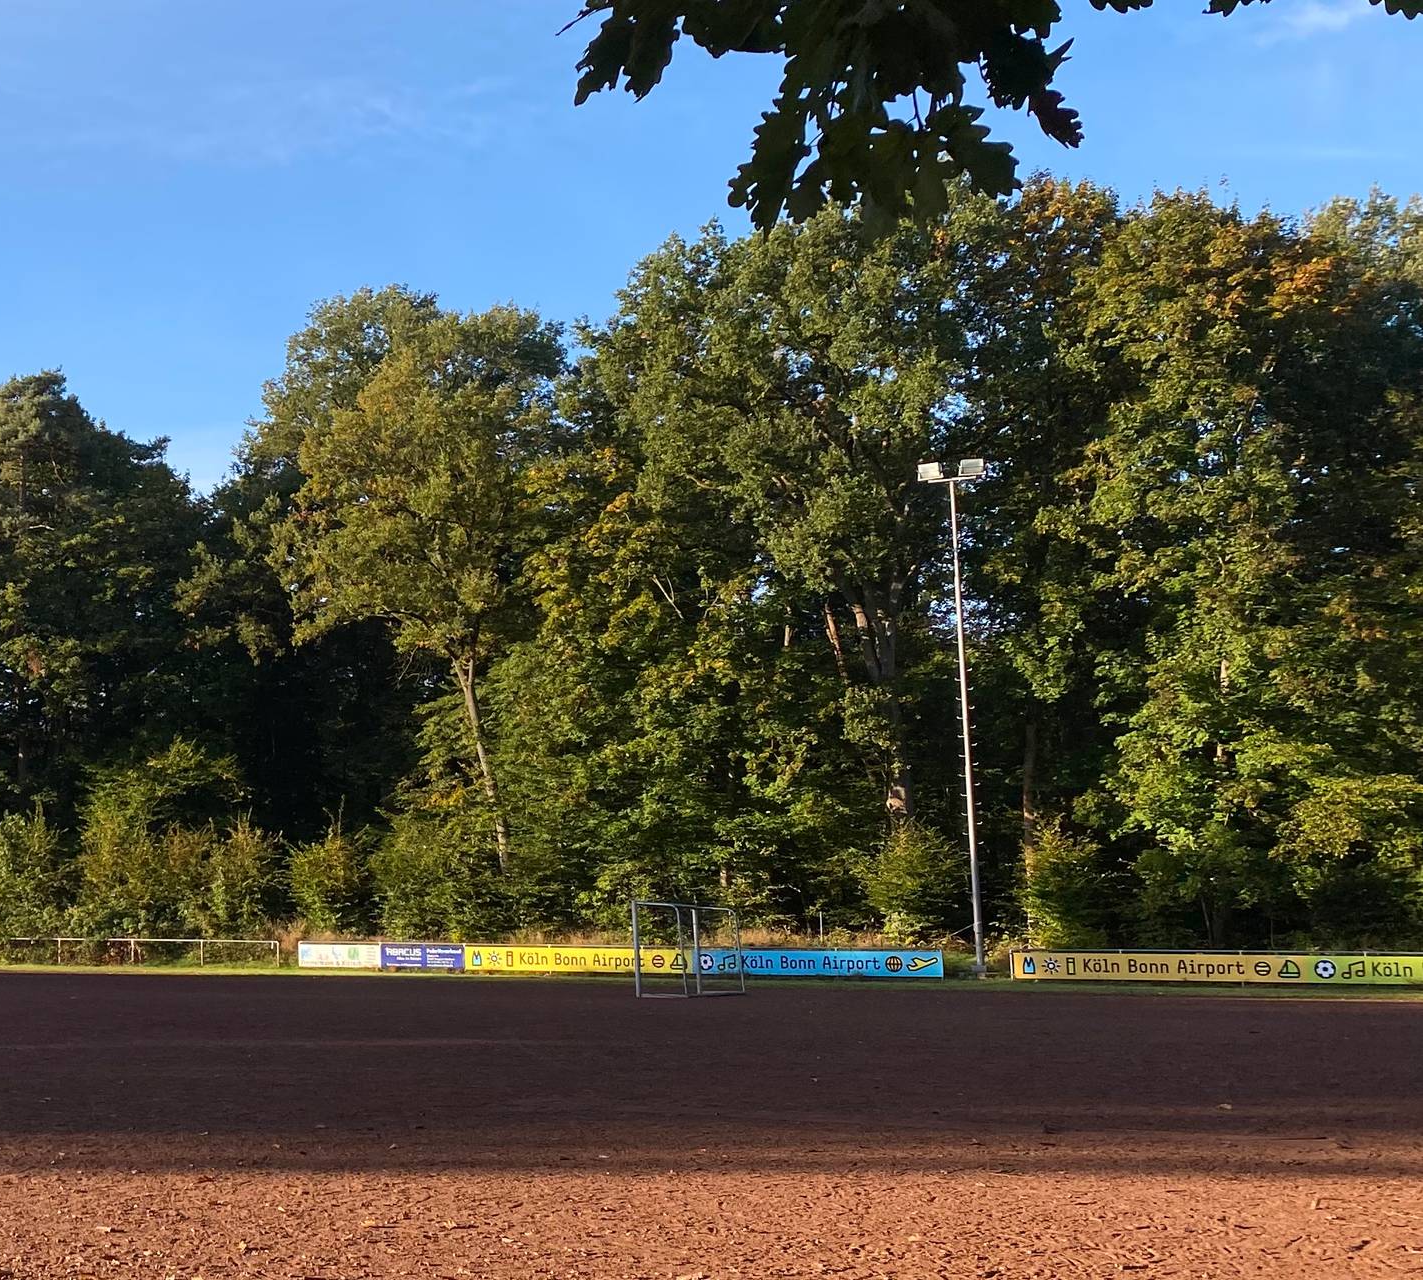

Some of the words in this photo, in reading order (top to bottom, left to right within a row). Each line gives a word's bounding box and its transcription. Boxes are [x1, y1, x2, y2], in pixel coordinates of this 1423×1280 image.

[519, 952, 549, 966] Köln
[554, 953, 587, 966] Bonn
[592, 954, 645, 972] Airport
[741, 955, 774, 969] Köln
[780, 956, 816, 970] Bonn
[822, 956, 881, 974] Airport
[1083, 958, 1120, 973] Köln
[1128, 959, 1170, 974] Bonn
[1177, 959, 1245, 978] Airport
[1371, 962, 1413, 977] Köln
